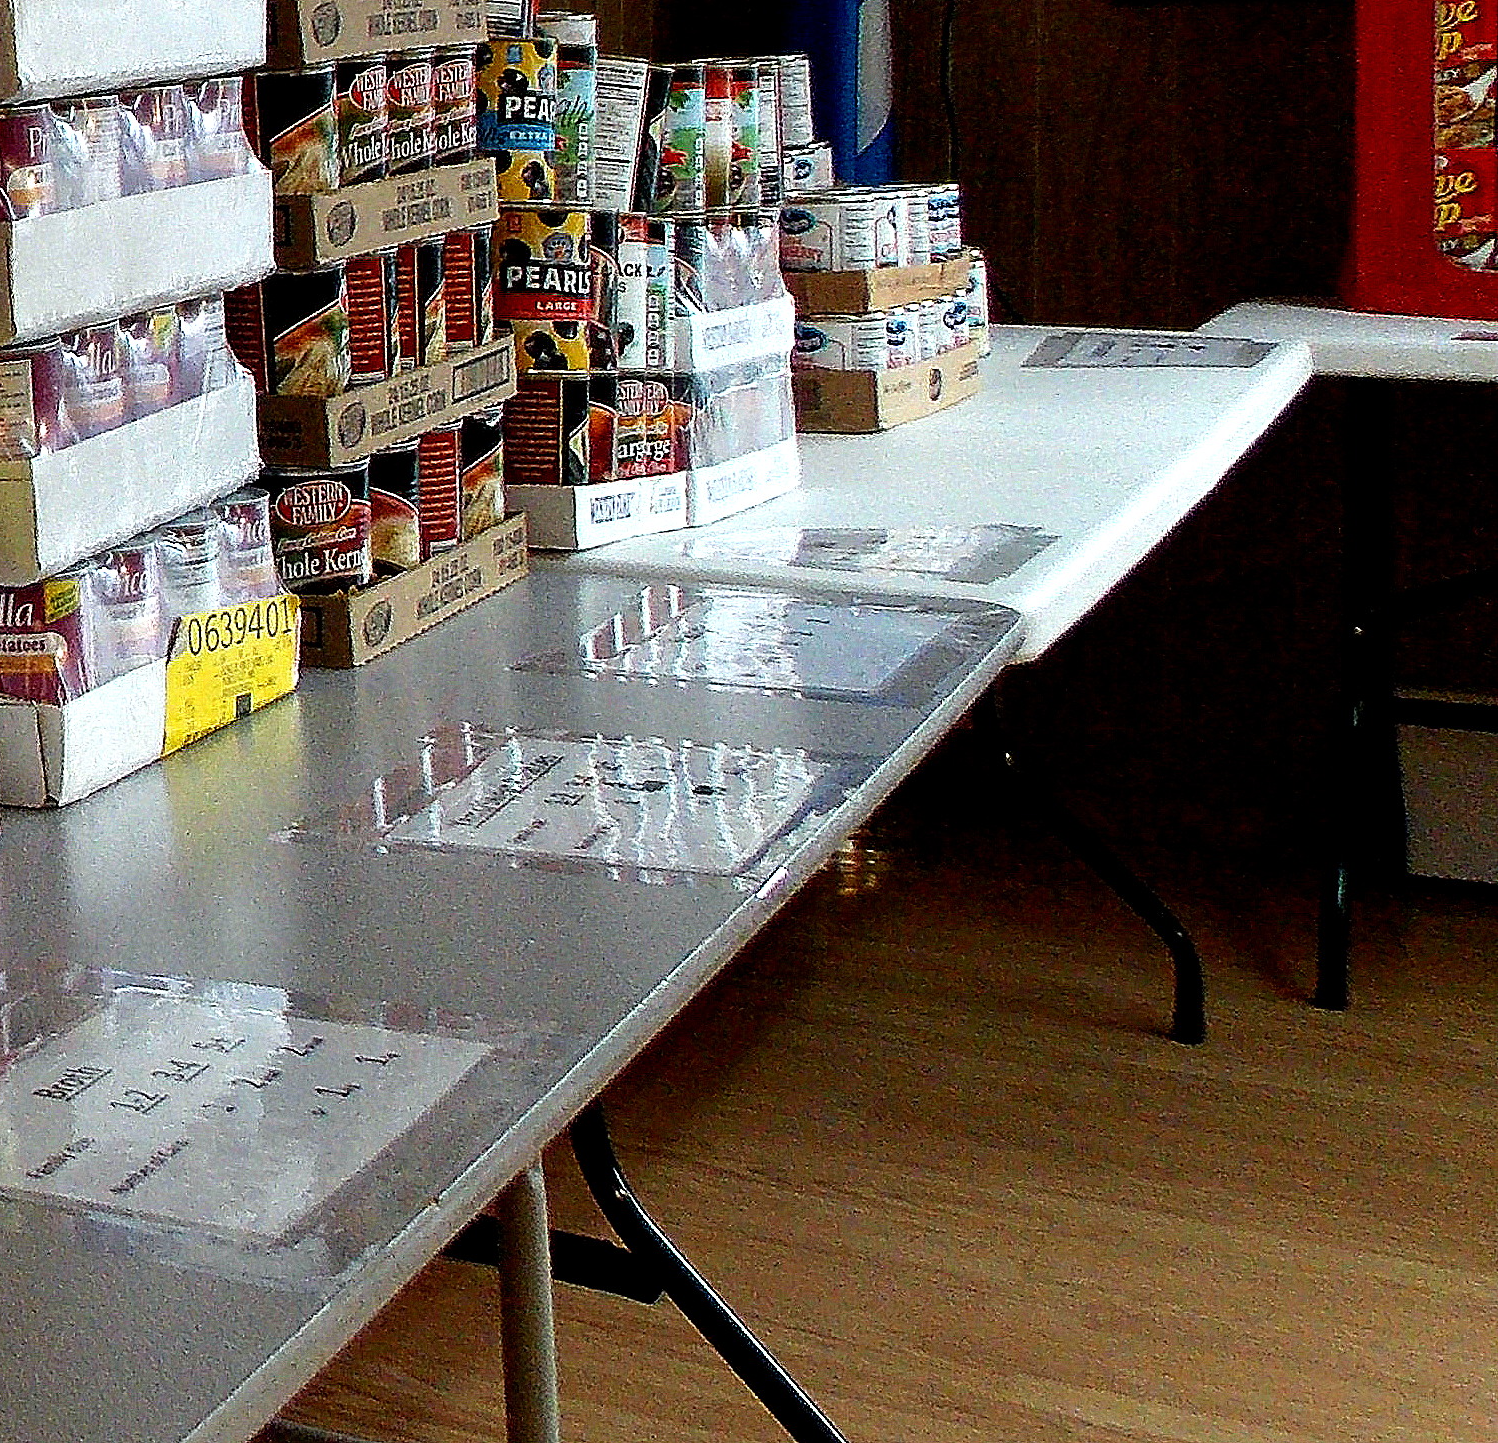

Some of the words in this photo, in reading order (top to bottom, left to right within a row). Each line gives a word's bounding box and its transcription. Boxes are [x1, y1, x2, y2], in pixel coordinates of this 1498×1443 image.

[536, 301, 577, 312] LARGE
[325, 548, 365, 573] Kern
[189, 603, 292, 656] 0639401
